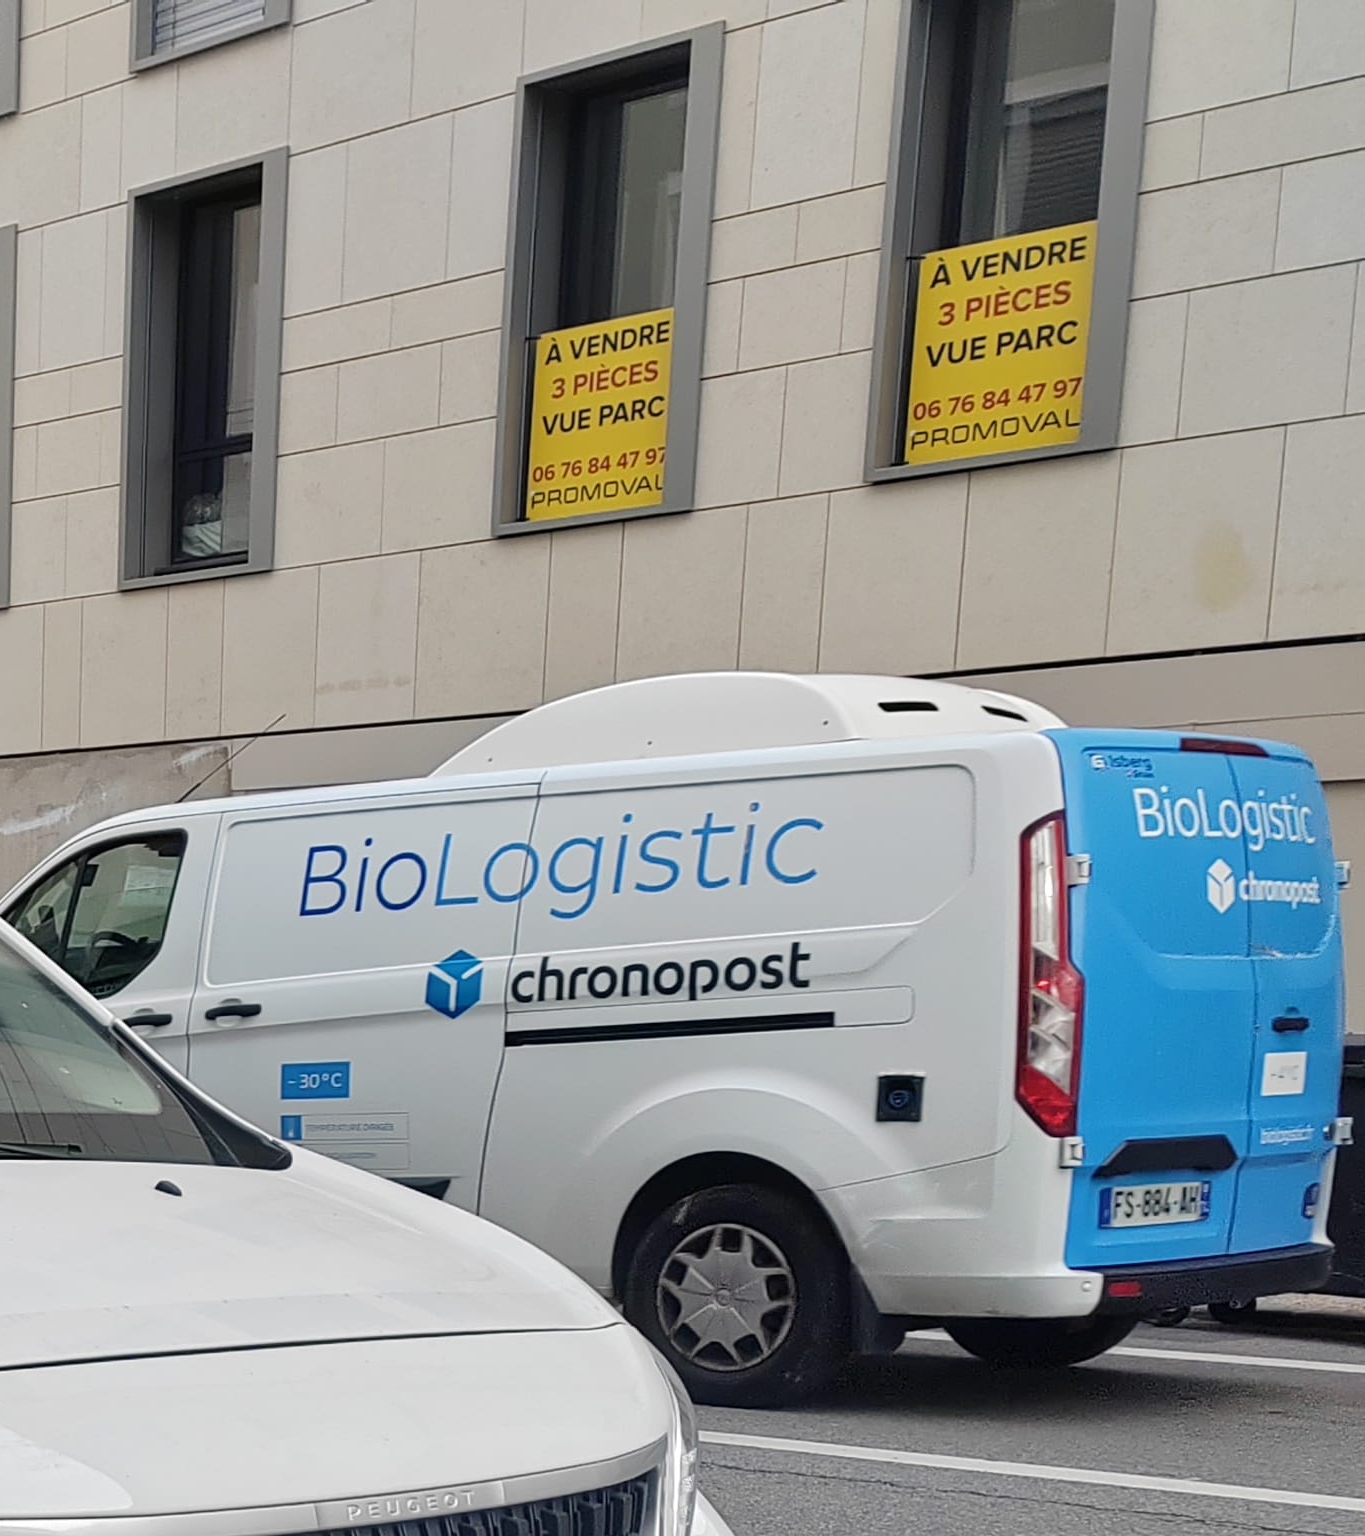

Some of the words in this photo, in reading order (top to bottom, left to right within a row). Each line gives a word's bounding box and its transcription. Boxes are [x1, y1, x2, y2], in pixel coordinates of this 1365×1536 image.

[930, 257, 951, 288] À
[961, 236, 1087, 282] VENDRE
[938, 302, 955, 327] 3
[965, 280, 1071, 321] PIÈCES
[545, 337, 562, 365] À
[570, 320, 670, 359] VENDRE
[926, 336, 987, 368] VUE
[996, 321, 1078, 356] PARC
[551, 378, 565, 399] 3
[573, 360, 659, 396] PIÈCES
[913, 400, 941, 421] 06
[948, 395, 975, 415] 76
[982, 389, 1010, 410] 84
[1017, 383, 1047, 404] 47
[1053, 377, 1082, 398] 97
[542, 408, 592, 436] VUE
[598, 395, 665, 427] PARC
[910, 408, 1081, 451] PROMOVAL
[533, 464, 555, 483] 06
[561, 460, 582, 479] 76
[588, 455, 611, 474] 84
[617, 450, 640, 470] 47
[530, 474, 663, 509] PROMOVAL
[1132, 785, 1317, 852] BioLogistic
[298, 801, 824, 920] BioLogistic
[1239, 870, 1322, 909] chronopost
[510, 942, 812, 1005] chronopost
[1114, 1186, 1200, 1219] FS-884-AH
[346, 1490, 475, 1521] PEUGEOT
